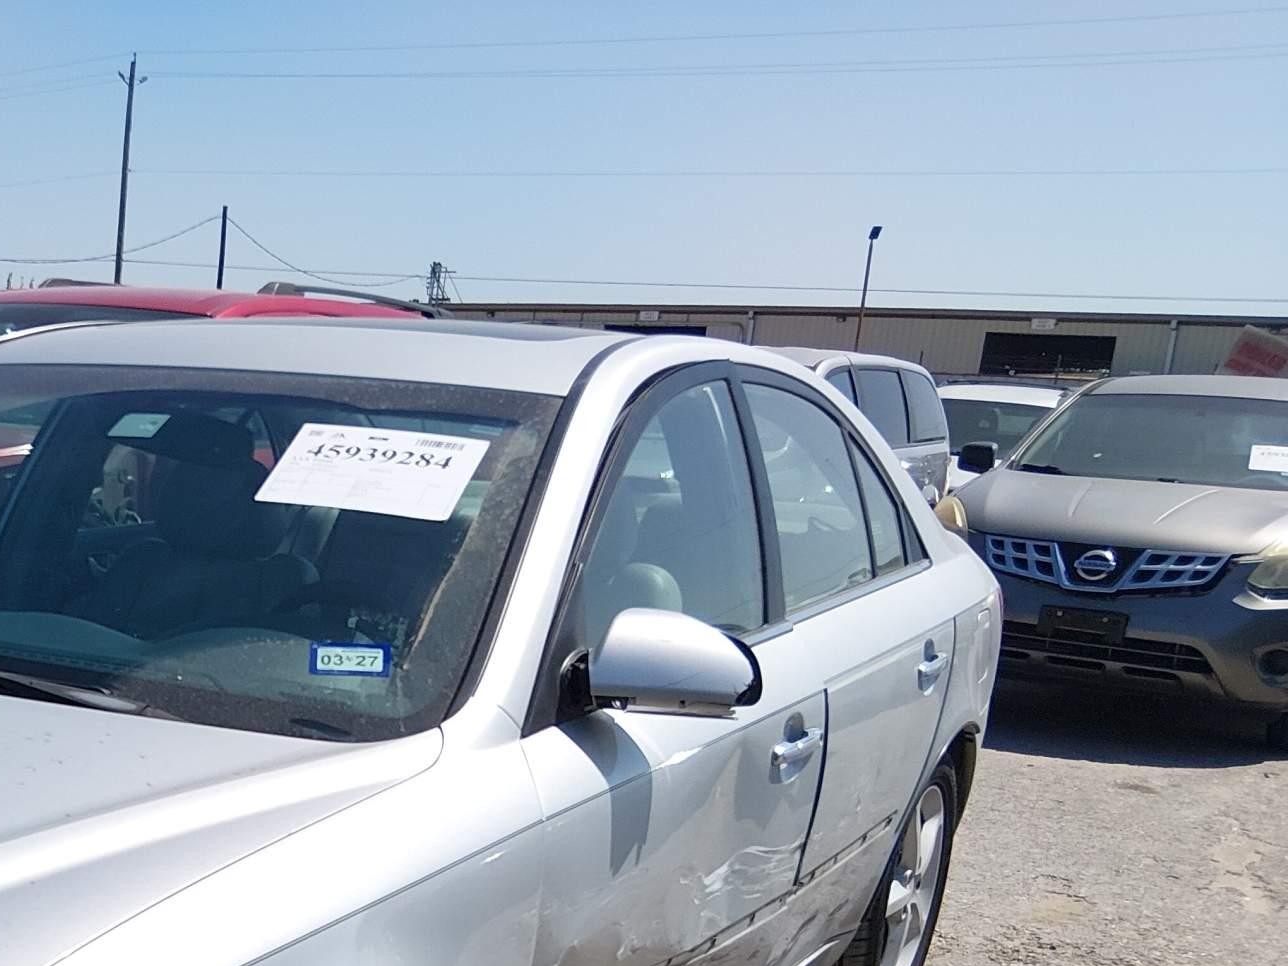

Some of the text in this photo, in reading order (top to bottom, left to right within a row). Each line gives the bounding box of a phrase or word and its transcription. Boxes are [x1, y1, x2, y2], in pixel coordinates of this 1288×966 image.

[307, 442, 454, 470] 45939284
[320, 654, 379, 667] 03 27
